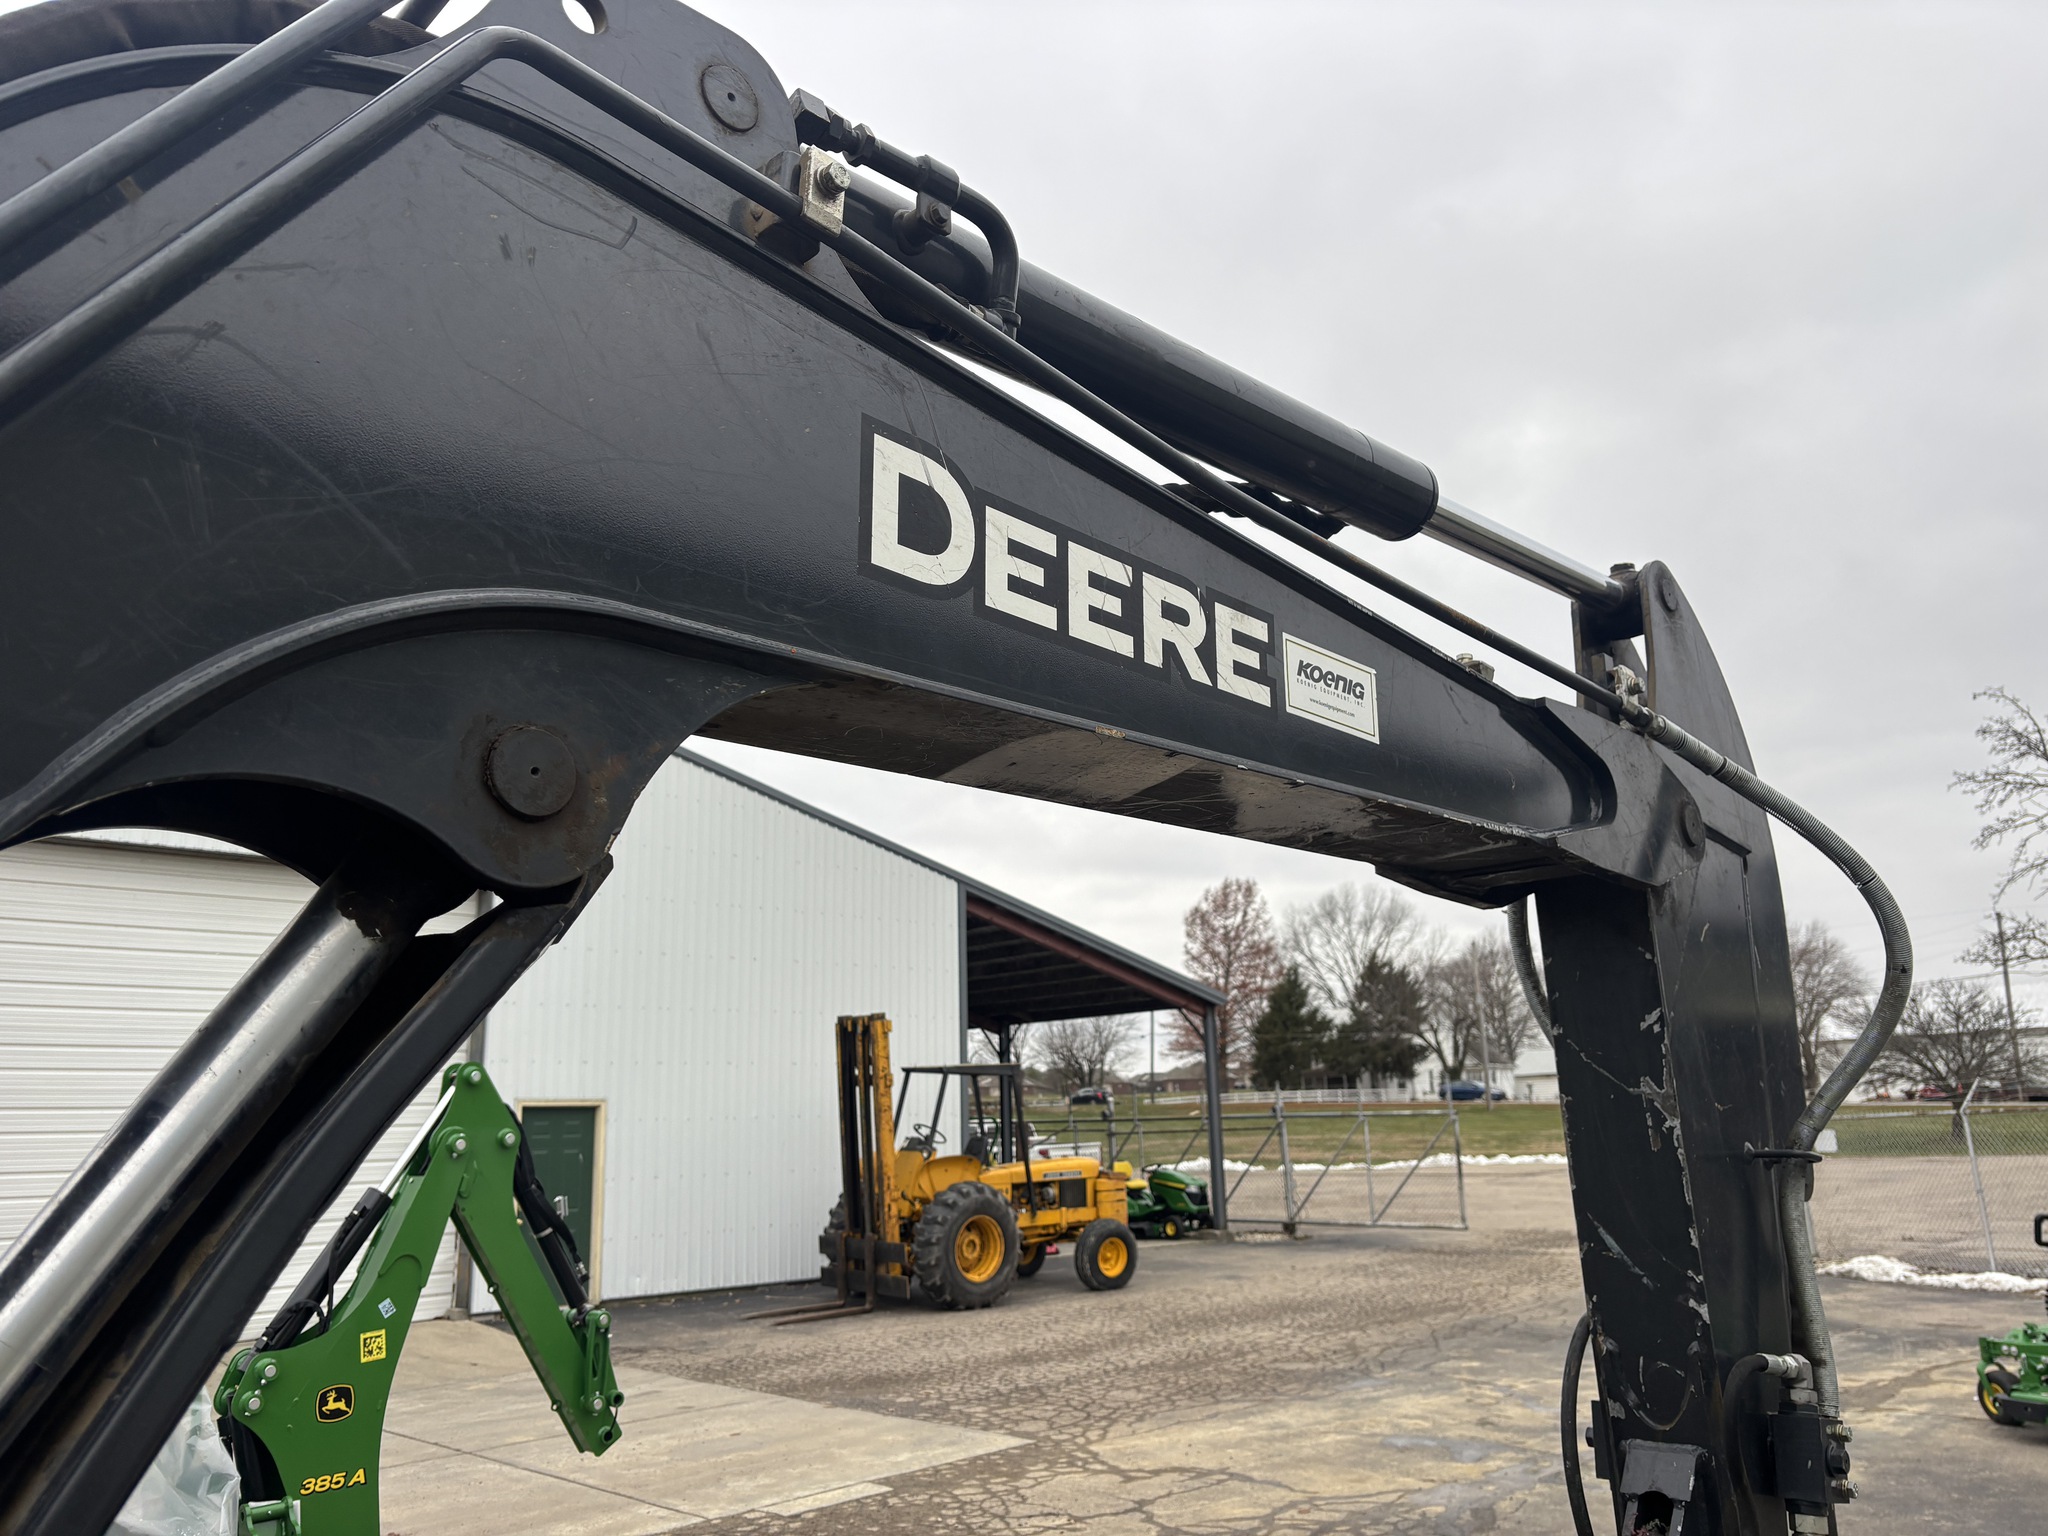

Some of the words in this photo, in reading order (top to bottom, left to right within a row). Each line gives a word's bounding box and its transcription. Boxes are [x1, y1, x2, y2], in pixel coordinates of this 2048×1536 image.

[871, 433, 1271, 708] DEERE
[1296, 677, 1318, 690] KOENIG
[299, 1471, 347, 1496] 385
[347, 1467, 367, 1489] A
